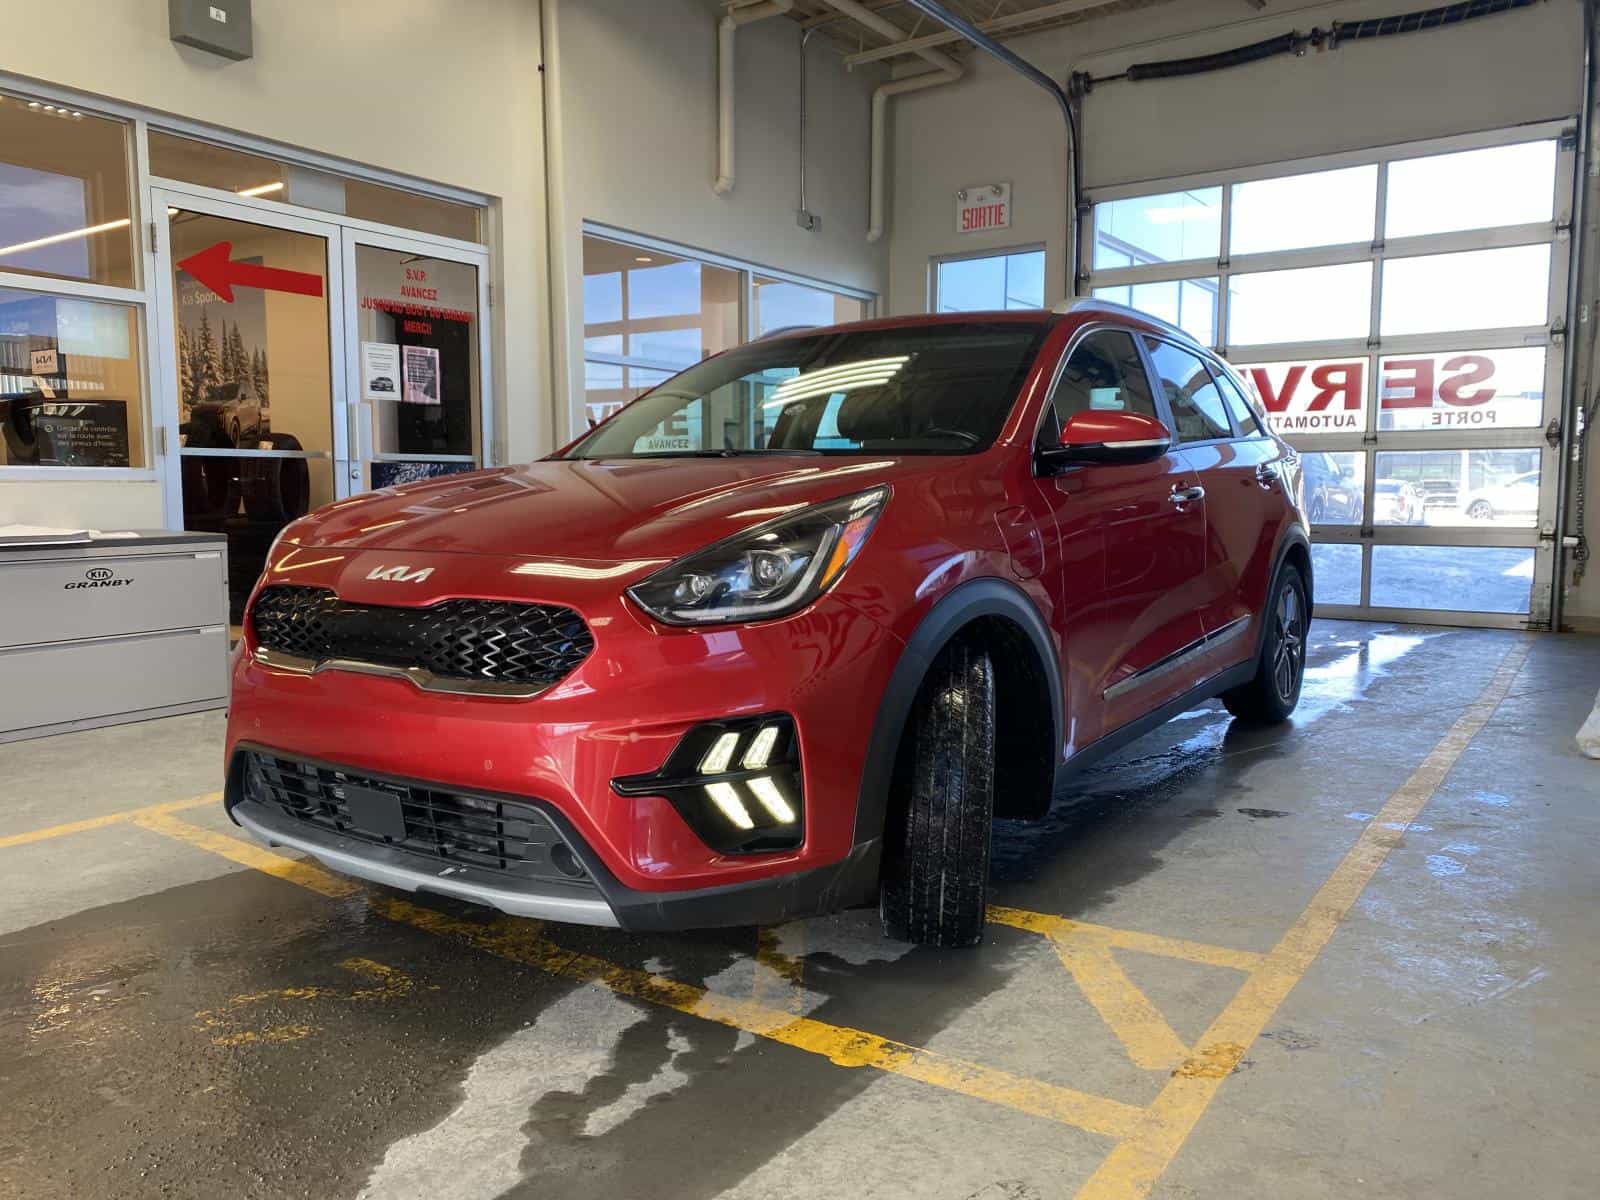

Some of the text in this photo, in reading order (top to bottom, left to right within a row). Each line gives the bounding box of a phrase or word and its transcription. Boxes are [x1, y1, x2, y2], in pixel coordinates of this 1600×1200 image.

[962, 203, 1005, 230] SORTIE
[400, 285, 437, 300] AVANCEZ
[365, 565, 436, 584] KIA
[64, 577, 135, 590] GRANBY
